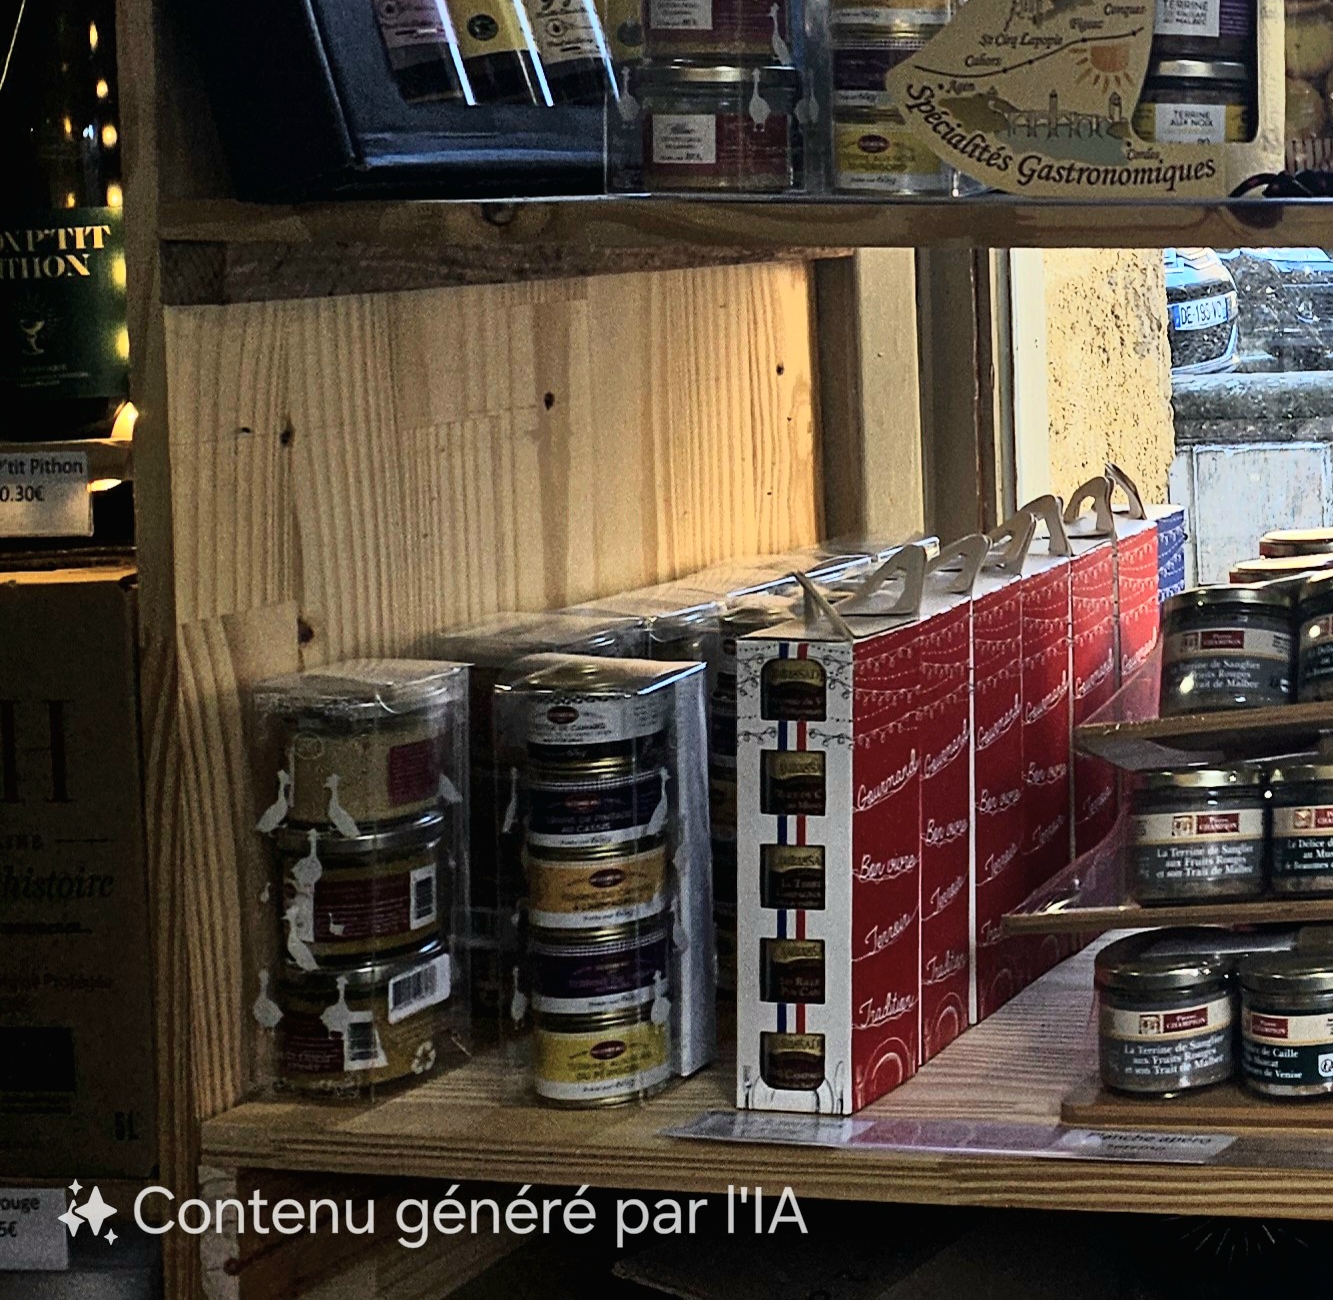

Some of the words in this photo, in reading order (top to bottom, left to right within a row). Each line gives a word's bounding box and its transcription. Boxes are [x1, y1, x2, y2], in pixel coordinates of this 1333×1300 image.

[905, 82, 1013, 172] Spécialités
[1017, 154, 1216, 191] Gastronomiques
[30, 458, 83, 475] Pithon
[857, 749, 920, 811] Gourmand
[860, 854, 884, 879] Bon
[859, 992, 917, 1027] Tradition
[1138, 1044, 1171, 1054] Terrine
[1273, 1049, 1299, 1059] Caille
[1153, 1053, 1182, 1065] Fruits
[1153, 1063, 1178, 1075] Trait
[1276, 1068, 1303, 1079] Venise
